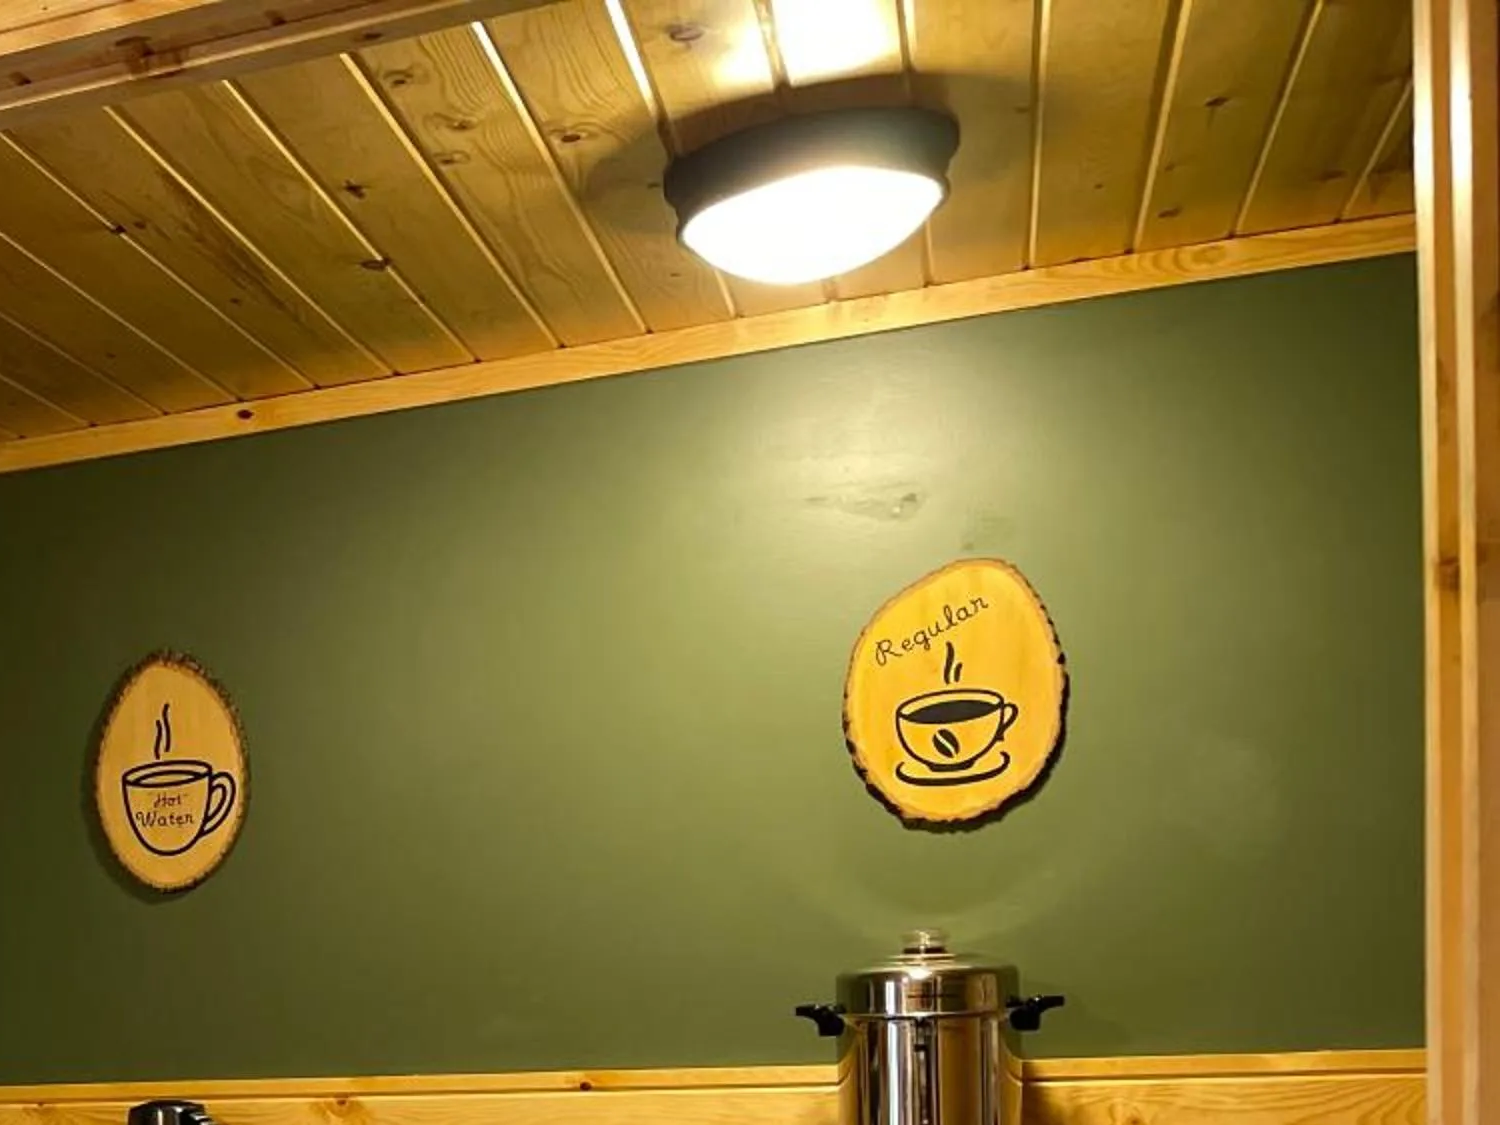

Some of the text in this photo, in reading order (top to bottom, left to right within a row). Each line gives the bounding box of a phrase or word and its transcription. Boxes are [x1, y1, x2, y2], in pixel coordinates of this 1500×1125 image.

[875, 597, 989, 666] Regular
[154, 793, 181, 808] Hot
[135, 811, 194, 827] Water
